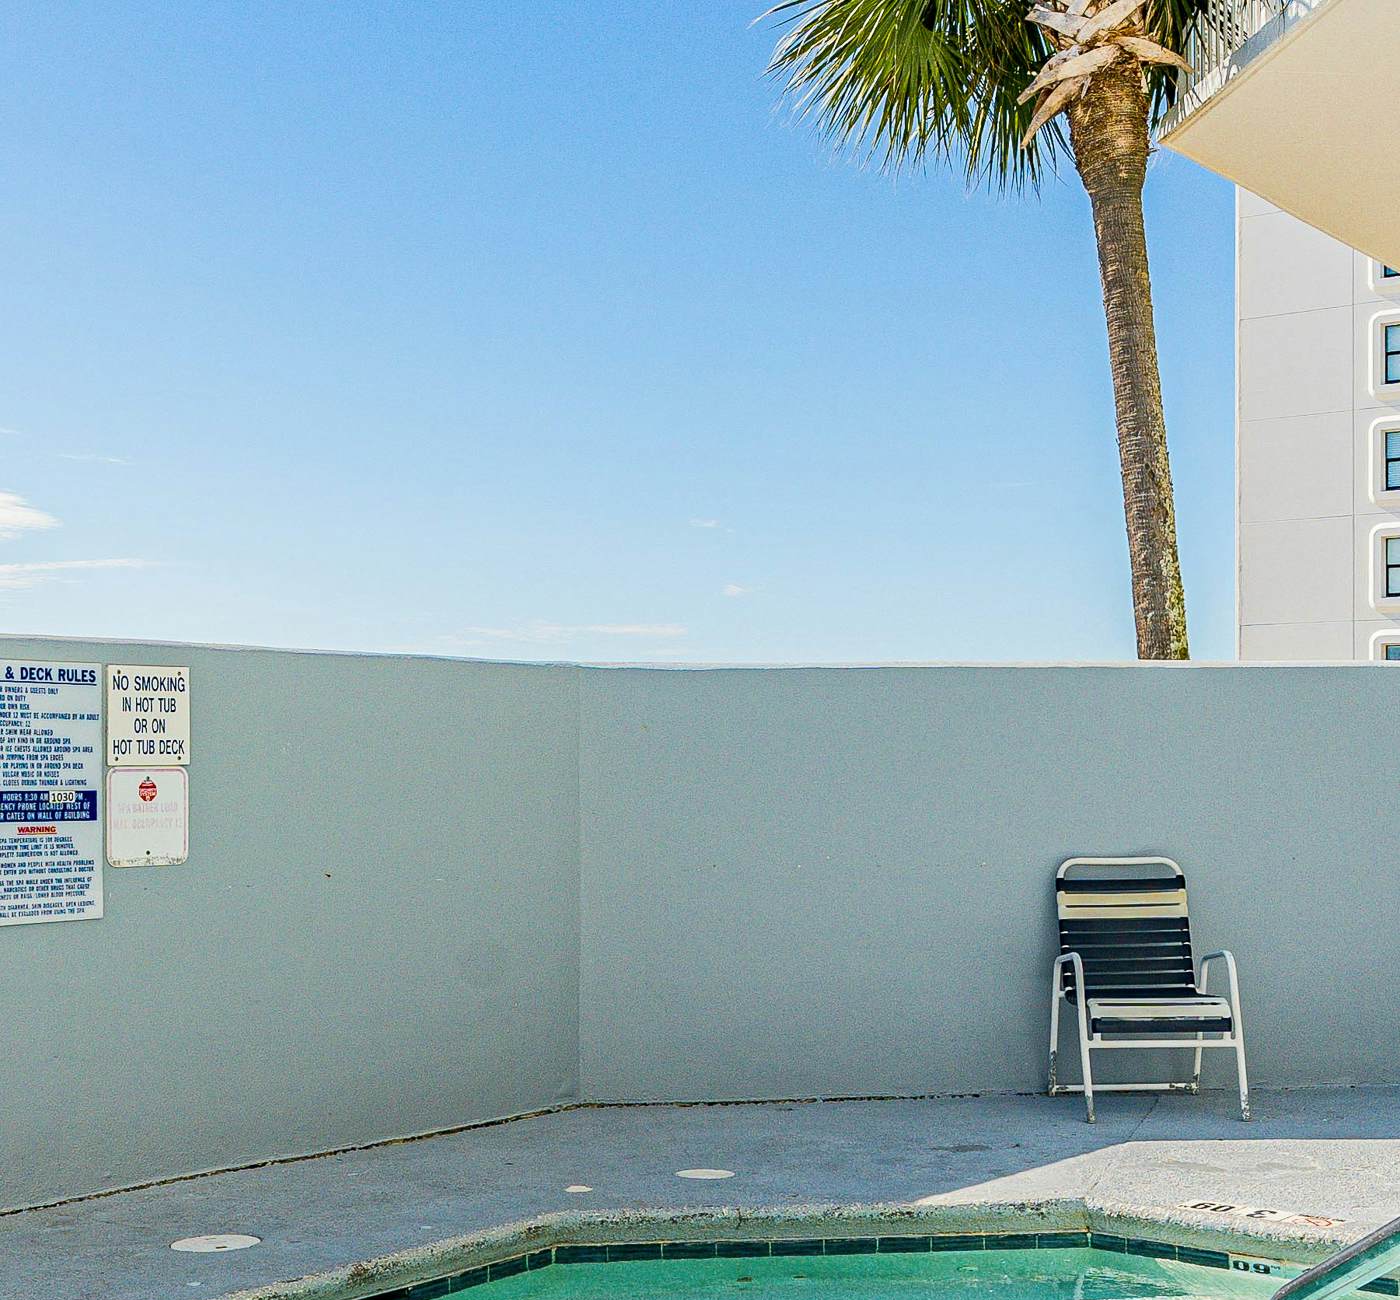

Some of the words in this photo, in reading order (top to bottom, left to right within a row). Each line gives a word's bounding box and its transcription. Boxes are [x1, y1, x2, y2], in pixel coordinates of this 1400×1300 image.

[5, 666, 14, 680] &
[20, 667, 53, 681] DECK
[58, 668, 96, 683] RULES
[112, 675, 129, 691] NO
[134, 676, 186, 692] SMOKING
[122, 697, 131, 712] IN
[135, 698, 154, 713] HOT
[158, 698, 177, 713] TUB
[134, 719, 148, 734] OR
[151, 719, 166, 734] ON
[113, 740, 133, 755] HOT
[136, 740, 156, 755] TUB
[159, 740, 185, 755] DECK
[3, 793, 22, 801] HOURS
[51, 792, 74, 802] 1030
[18, 802, 37, 811] PHONE
[39, 802, 64, 810] LOCATED
[66, 802, 81, 810] WEST
[83, 801, 91, 809] OF
[6, 812, 25, 820] GATES
[26, 812, 35, 820] ON
[37, 812, 53, 820] WALL
[54, 811, 62, 820] OF
[64, 811, 90, 819] BUILDING
